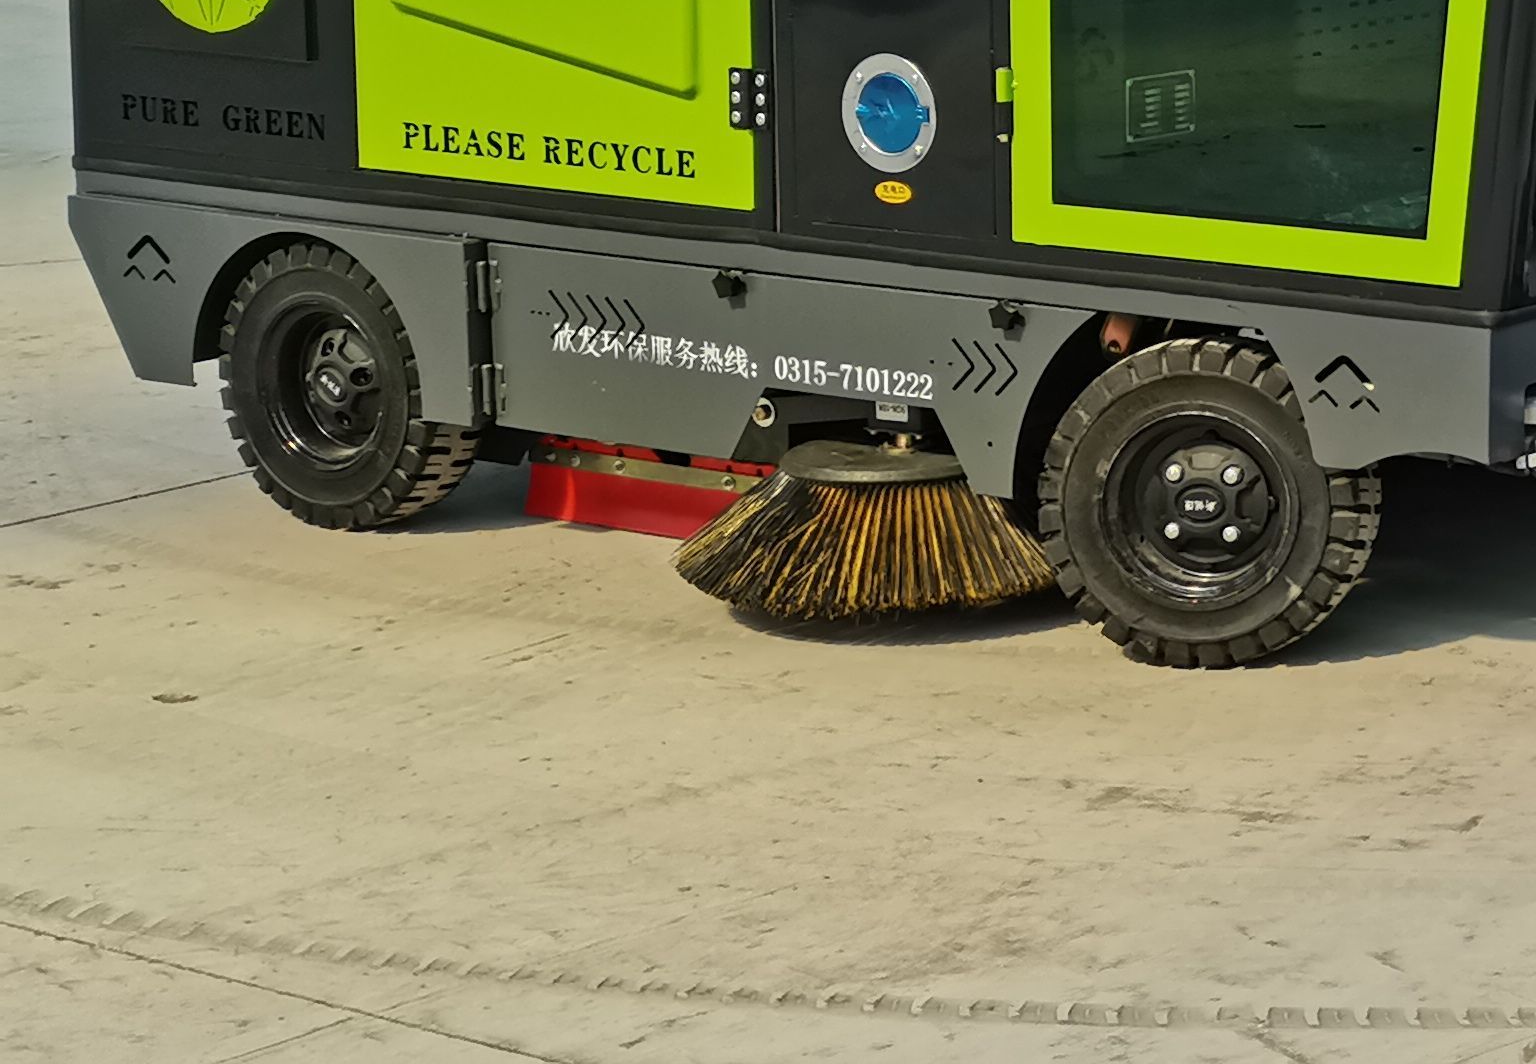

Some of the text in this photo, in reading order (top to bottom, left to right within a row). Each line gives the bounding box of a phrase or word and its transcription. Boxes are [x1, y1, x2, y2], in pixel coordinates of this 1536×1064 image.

[121, 94, 327, 141] PURE GREEN
[402, 122, 697, 179] PLEASE RECYCLE
